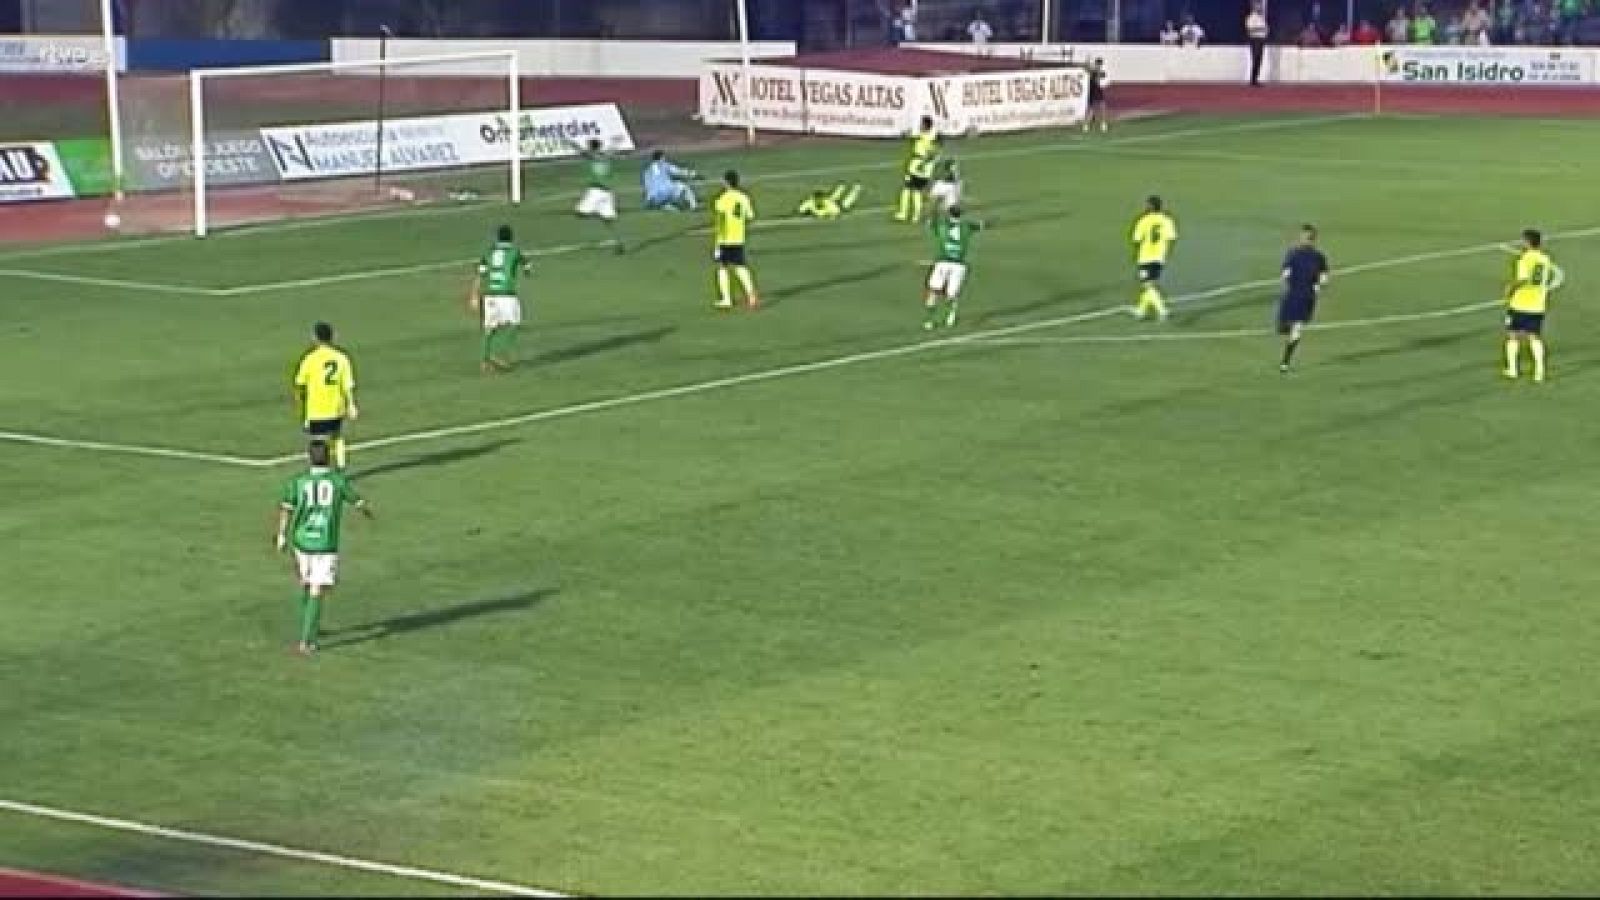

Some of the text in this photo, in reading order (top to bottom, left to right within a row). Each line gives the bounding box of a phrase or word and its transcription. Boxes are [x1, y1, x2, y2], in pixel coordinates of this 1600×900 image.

[1402, 60, 1449, 81] San
[1457, 60, 1523, 81] Isidro
[323, 361, 339, 386] 2
[303, 479, 334, 506] 10
